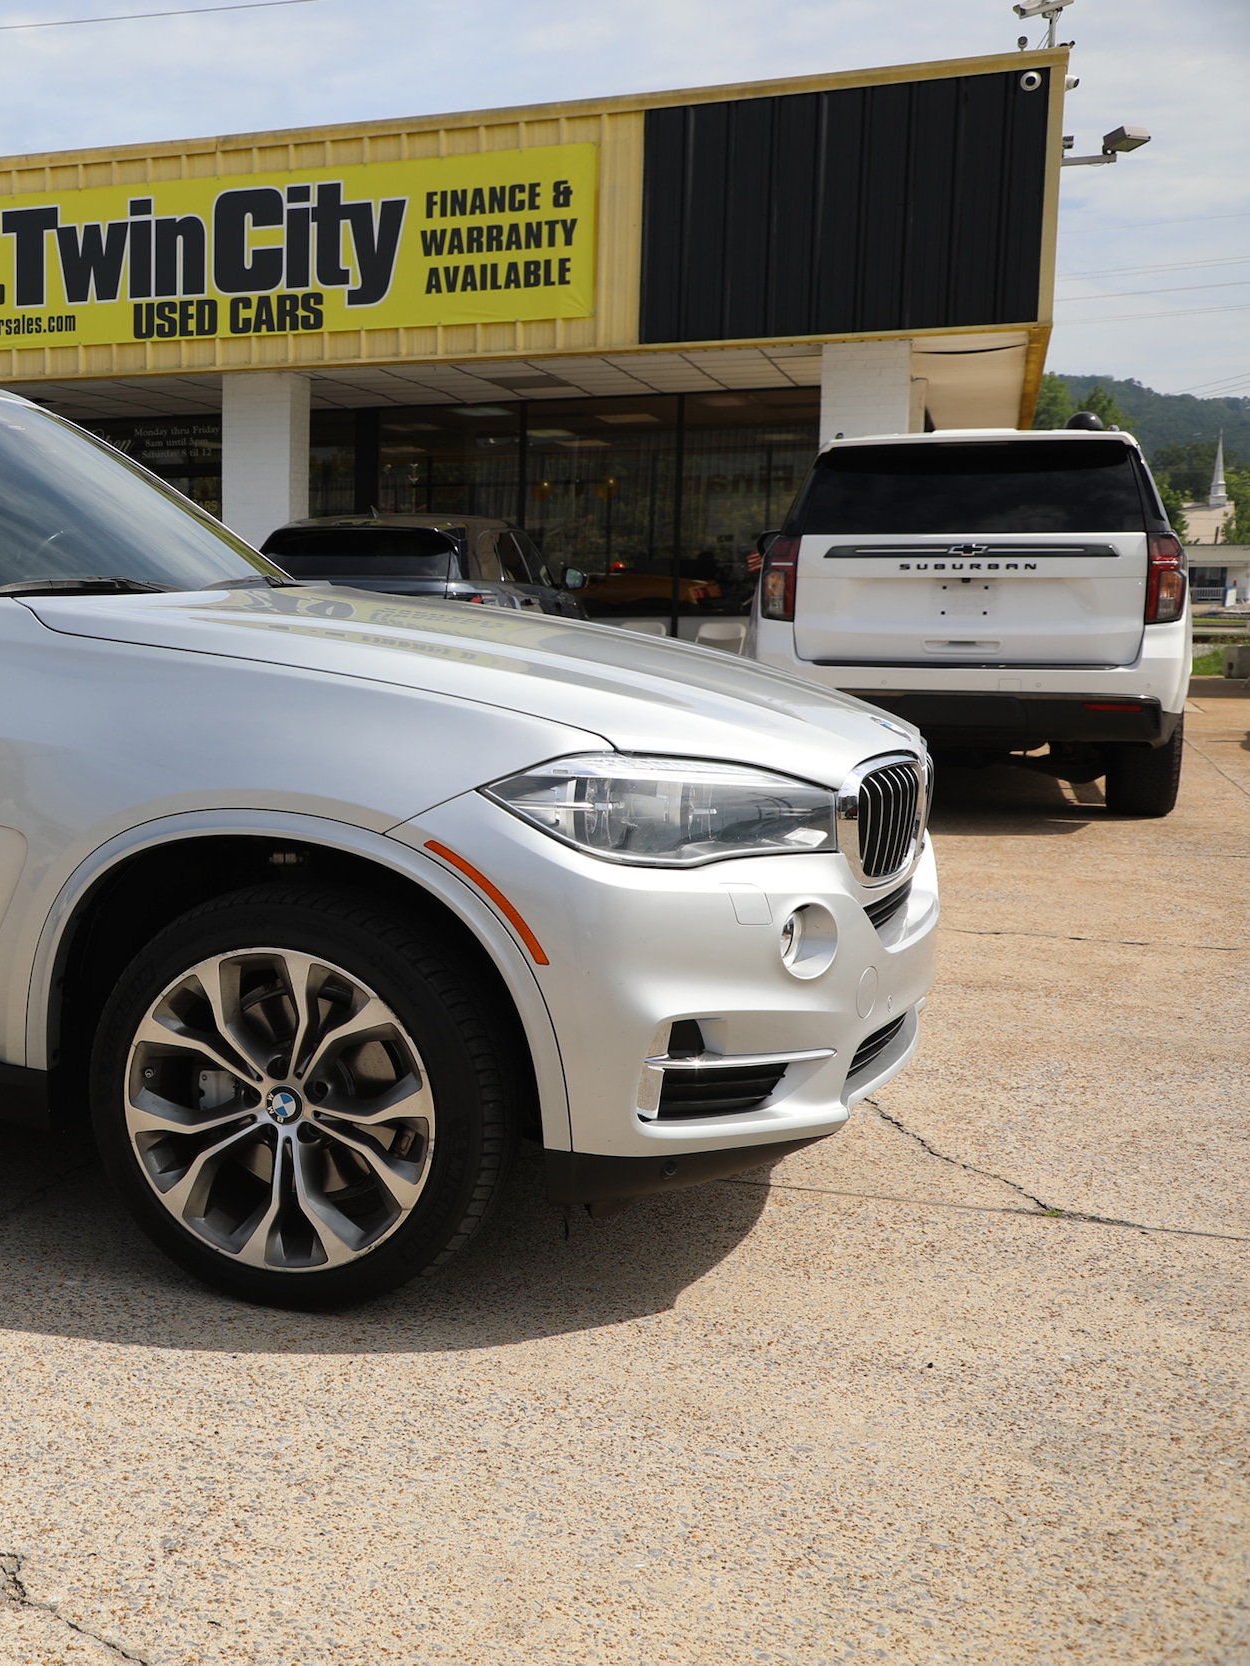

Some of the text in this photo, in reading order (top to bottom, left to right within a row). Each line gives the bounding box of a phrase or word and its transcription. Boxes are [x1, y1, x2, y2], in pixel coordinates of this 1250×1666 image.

[425, 180, 573, 219] FINANCE &
[420, 218, 578, 257] WARRANTY
[425, 257, 571, 295] AVAILABLE
[133, 292, 324, 339] USED CARS
[134, 425, 220, 438] Monday thru Friday
[145, 437, 209, 448] 8am until 5pm
[141, 450, 179, 460] Saturday
[190, 448, 199, 457] til
[201, 448, 212, 456] 12
